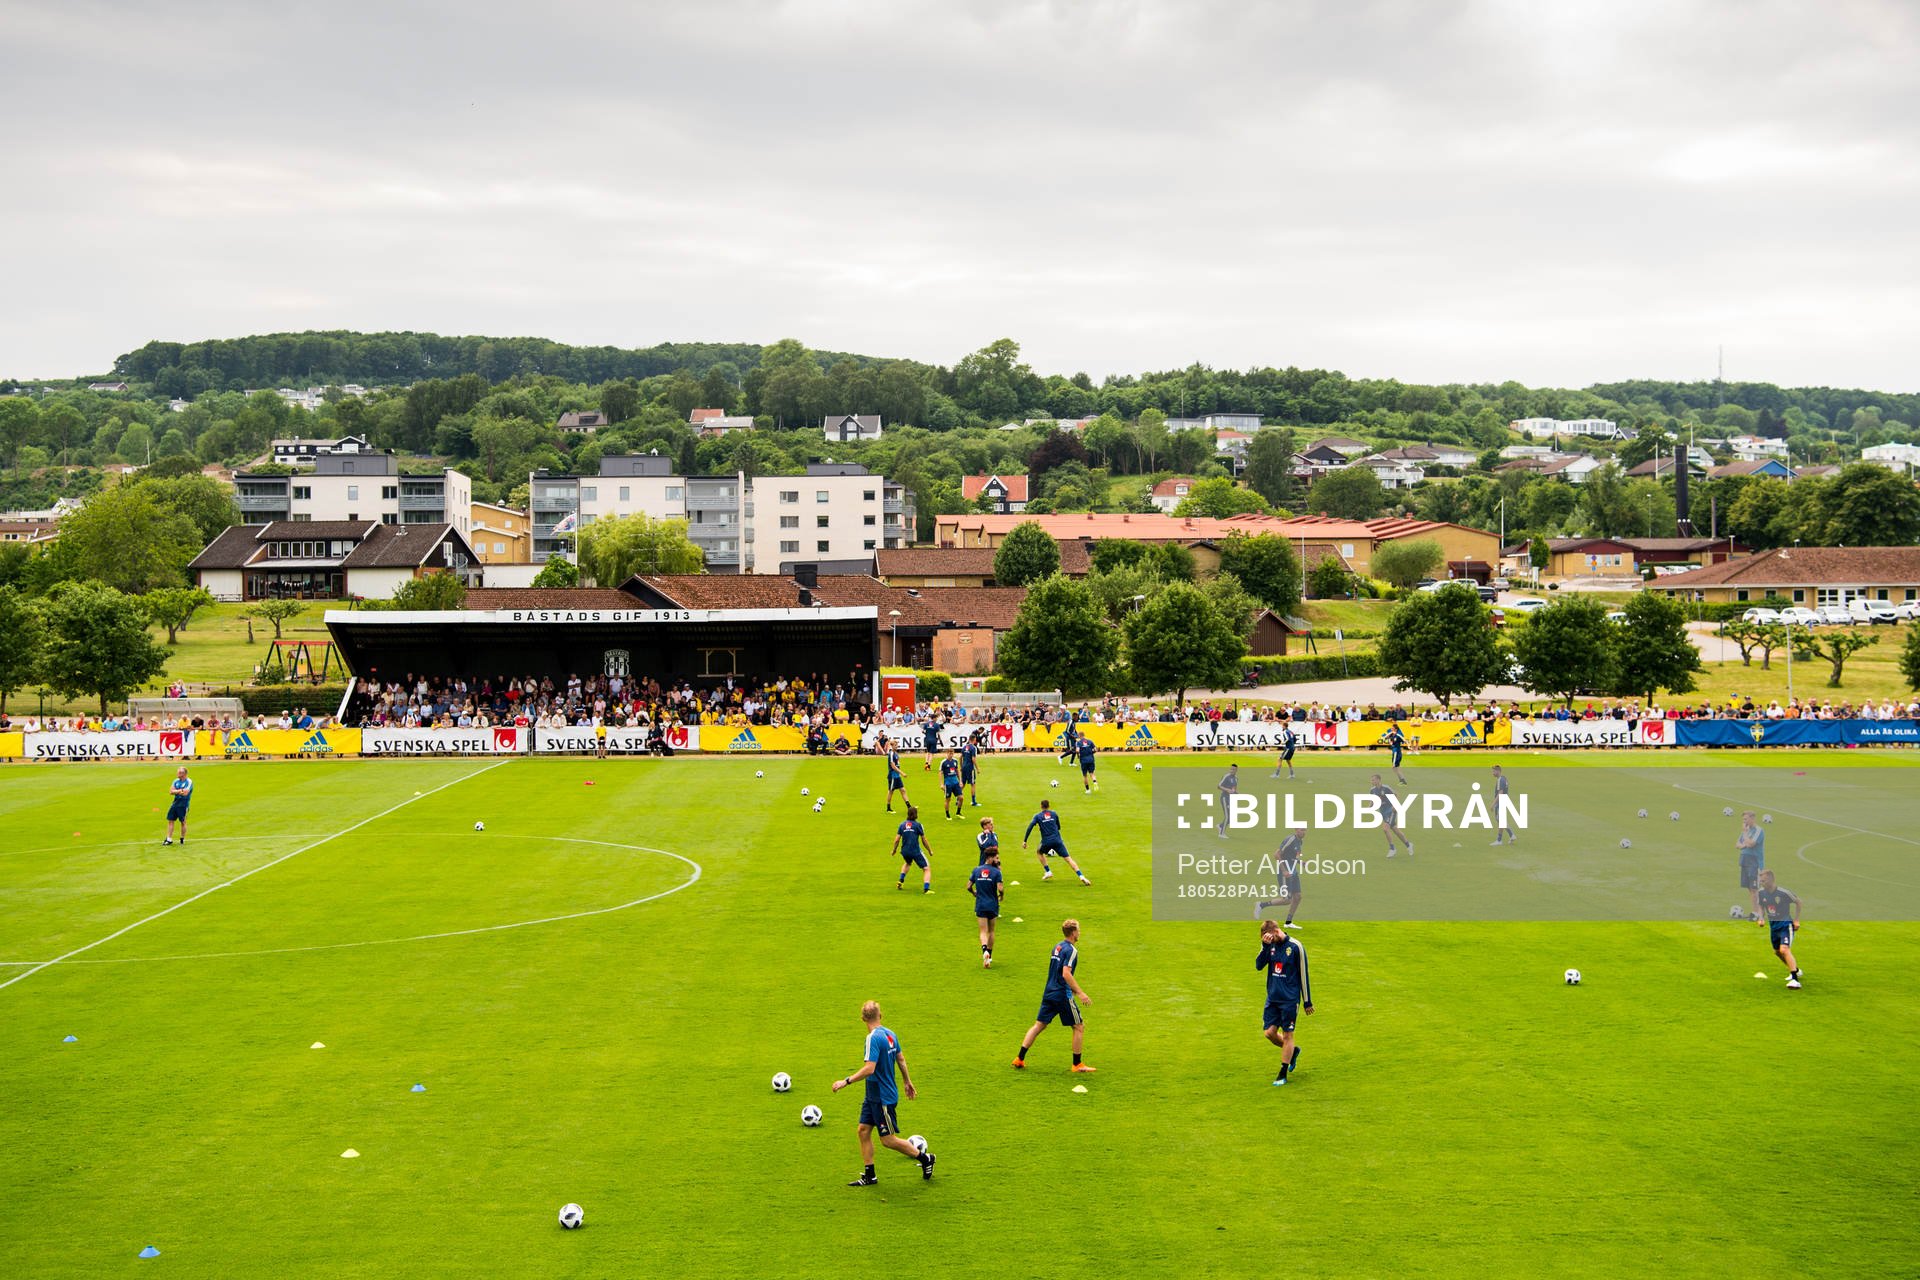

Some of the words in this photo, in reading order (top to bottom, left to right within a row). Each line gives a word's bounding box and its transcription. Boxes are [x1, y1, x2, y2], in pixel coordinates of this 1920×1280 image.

[513, 611, 601, 621] BÅSTADS
[613, 611, 642, 621] GIF
[654, 611, 690, 620] 1913
[1860, 728, 1881, 736] ALLA
[1894, 728, 1918, 736] OLIKA
[1125, 738, 1158, 747] adidas
[1196, 734, 1268, 746] SVENSKA
[1273, 734, 1311, 746] SEL
[1449, 735, 1483, 744] adidas
[1522, 732, 1594, 744] SVENSKA
[1600, 732, 1638, 744] SPEL
[225, 744, 259, 754] adidas
[299, 744, 334, 753] adidas
[374, 740, 446, 752] SVENSKA
[452, 739, 490, 751] SPEL
[547, 738, 619, 750] SVENSA
[728, 741, 762, 751] adidas
[37, 743, 110, 756] SVENSKA
[116, 743, 156, 755] SPEL
